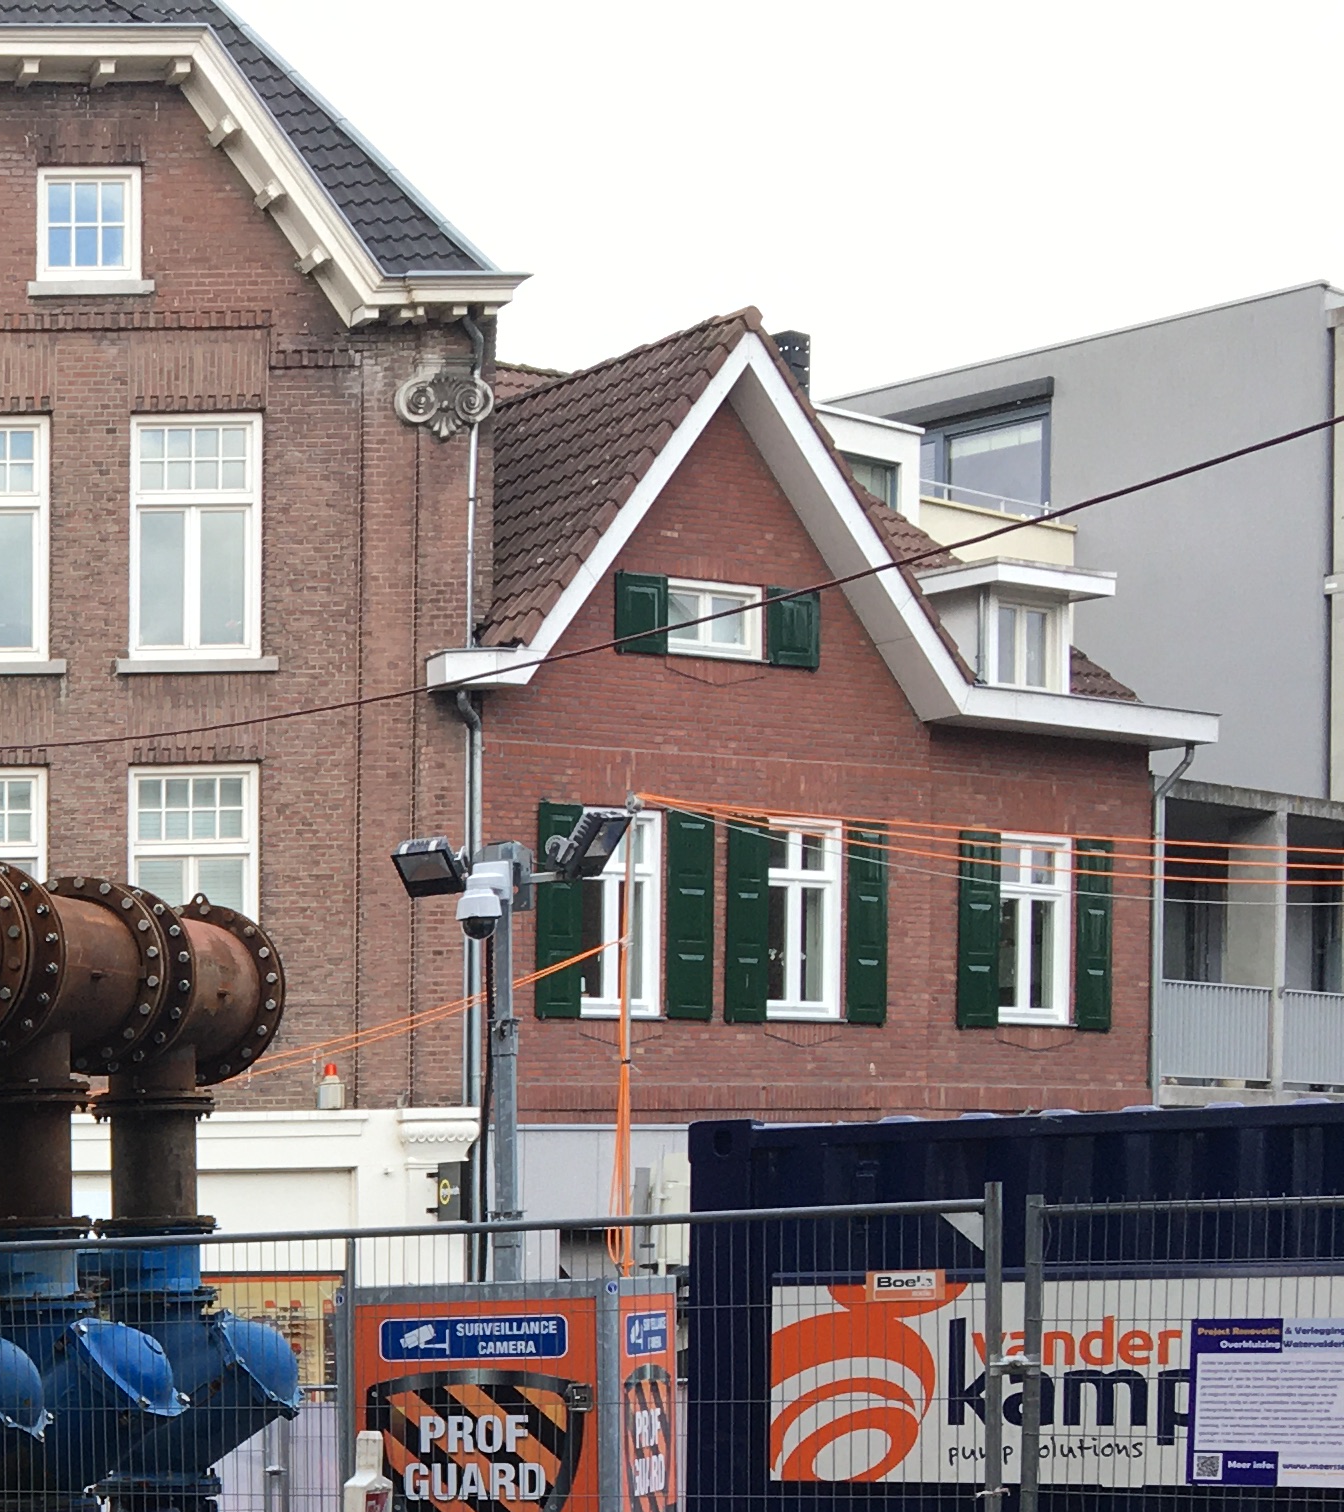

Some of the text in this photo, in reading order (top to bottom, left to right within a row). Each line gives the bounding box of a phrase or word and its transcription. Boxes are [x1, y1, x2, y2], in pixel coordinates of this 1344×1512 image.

[455, 1320, 558, 1337] SURVEILLANCE
[1197, 1327, 1230, 1338] Project
[1232, 1326, 1280, 1336] Renovatie
[478, 1339, 536, 1355] CAMERA
[419, 1414, 530, 1454] PROF
[948, 1436, 1144, 1466] pup olutions
[1227, 1460, 1251, 1469] Meer
[403, 1462, 547, 1502] GUARD
